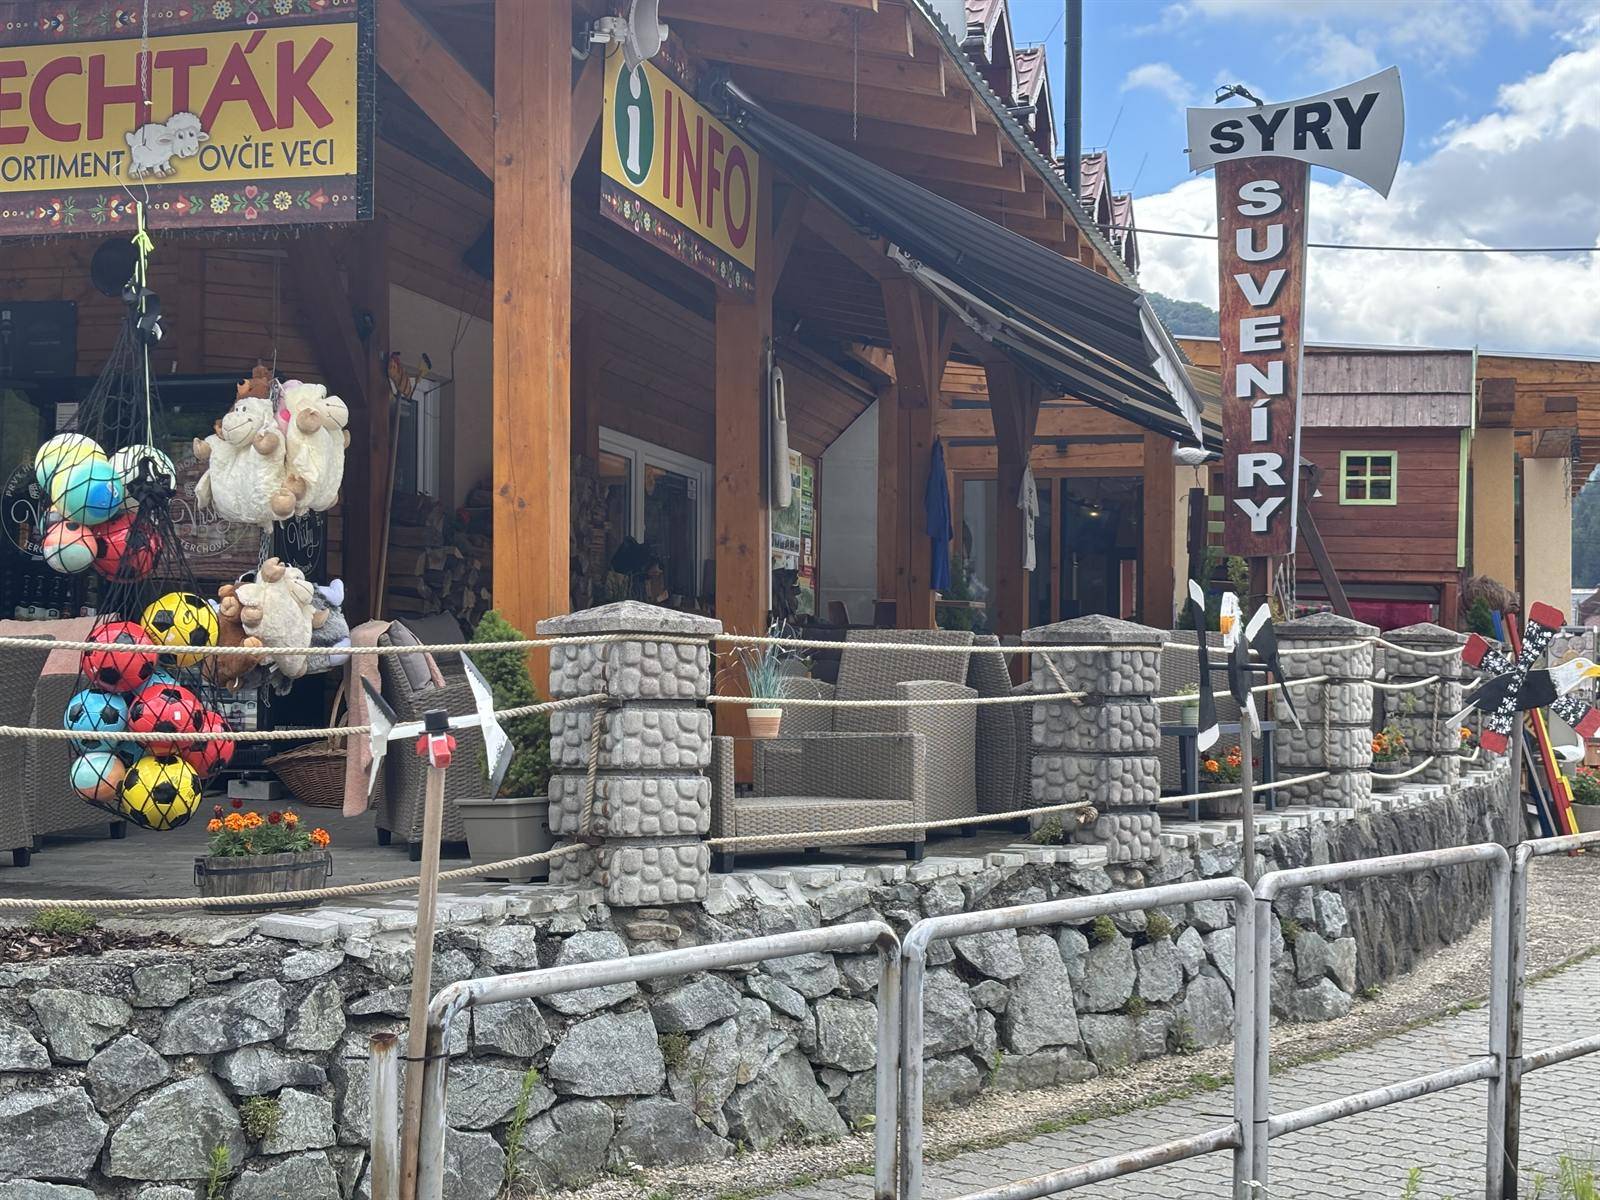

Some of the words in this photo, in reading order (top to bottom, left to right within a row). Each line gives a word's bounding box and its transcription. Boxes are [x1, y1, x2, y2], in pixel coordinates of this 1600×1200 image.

[1, 150, 125, 182] ORTIMENT
[200, 135, 274, 171] OVČIE
[281, 139, 334, 167] VECI
[662, 89, 751, 250] INFO
[1209, 92, 1380, 154] SYRY
[1233, 179, 1288, 532] SUVENÍRY
